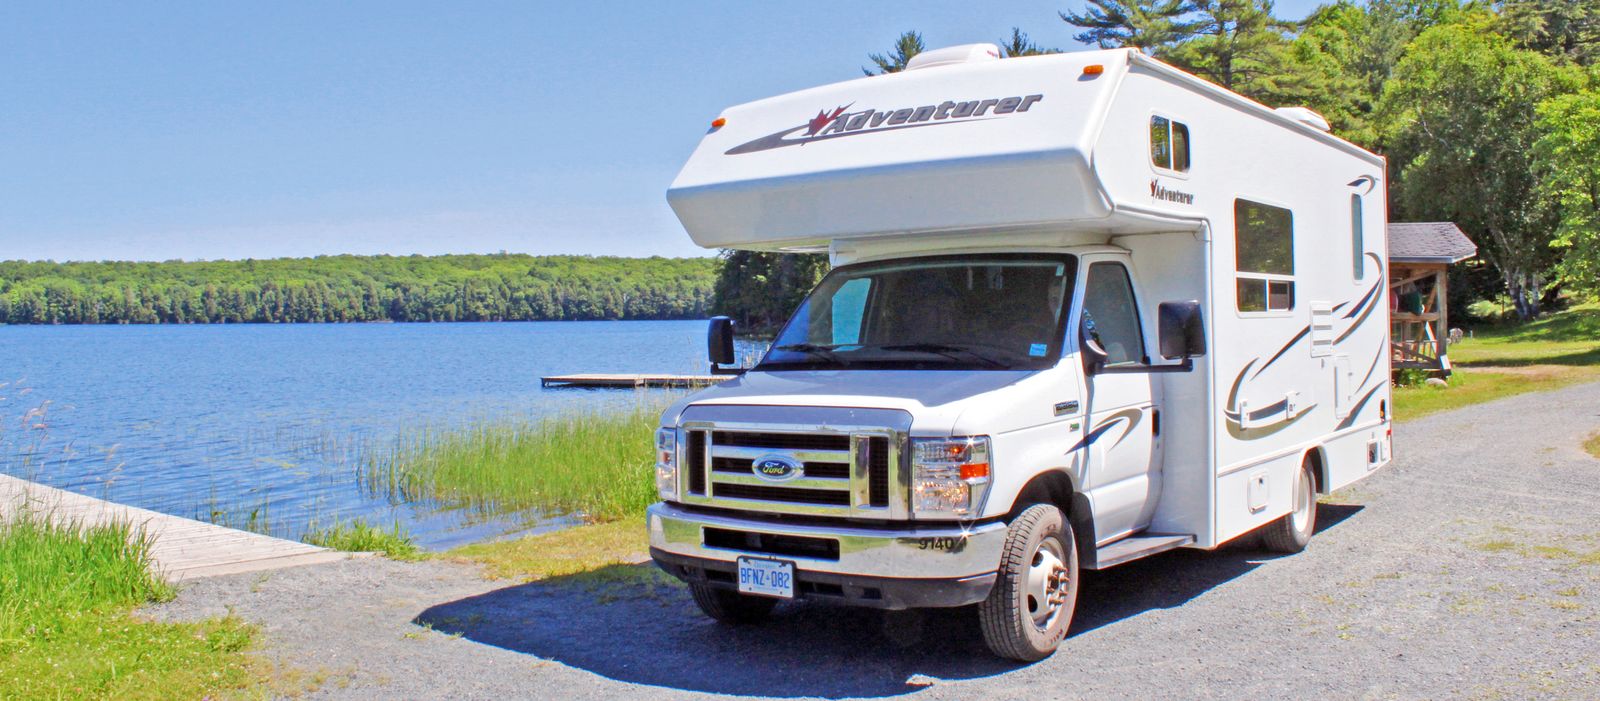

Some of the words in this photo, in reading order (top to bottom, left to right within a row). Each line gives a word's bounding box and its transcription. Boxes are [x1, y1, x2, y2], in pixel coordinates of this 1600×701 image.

[821, 94, 1044, 135] Adventurer
[1155, 184, 1194, 205] Adventurer
[762, 461, 785, 475] Ford
[919, 537, 954, 550] 9140
[740, 567, 765, 586] BFNZ
[771, 570, 790, 589] 082
